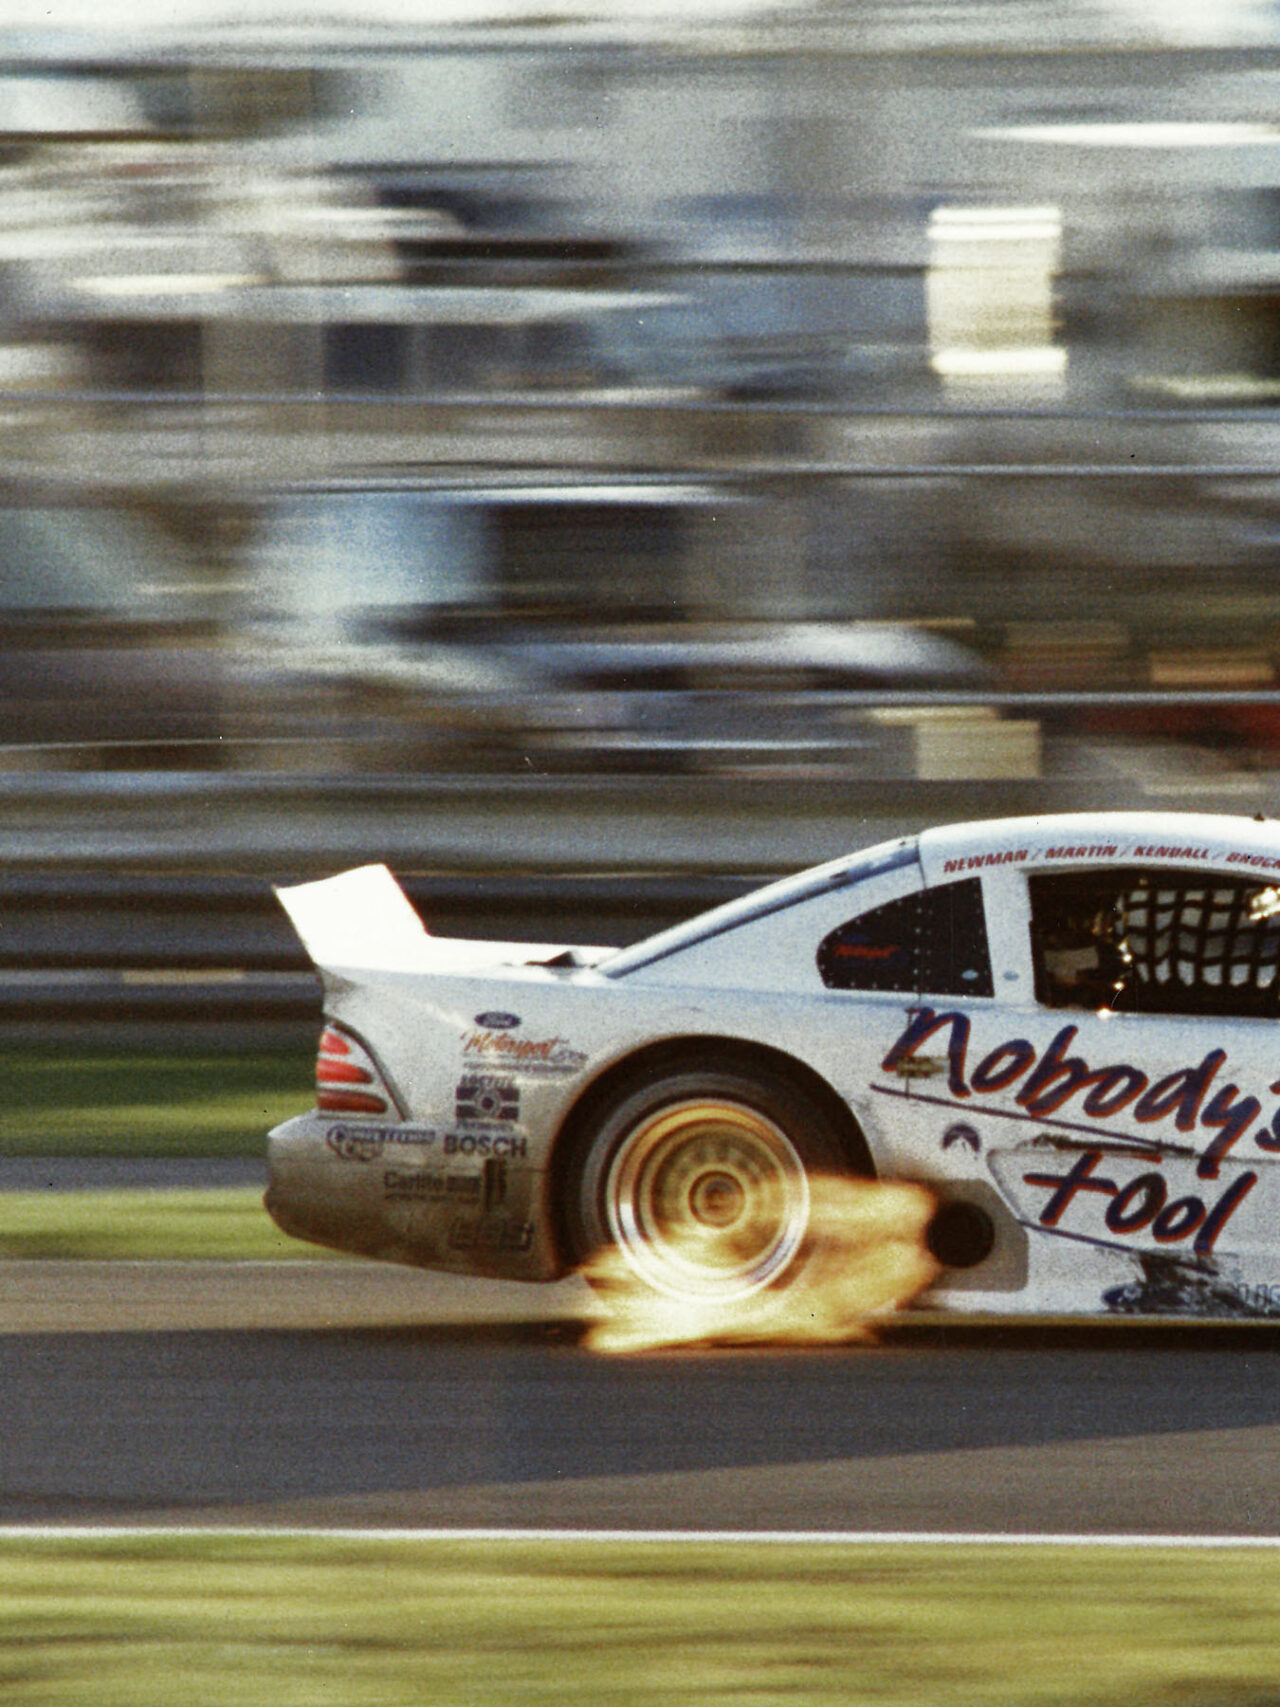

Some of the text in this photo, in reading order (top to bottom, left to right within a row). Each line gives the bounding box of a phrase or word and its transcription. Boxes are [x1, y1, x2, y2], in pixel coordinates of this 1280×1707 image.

[943, 849, 1028, 873] NEWMAN
[1044, 844, 1118, 859] MARTIN
[1133, 845, 1210, 860] KENDALL
[443, 1133, 528, 1159] BOSCH
